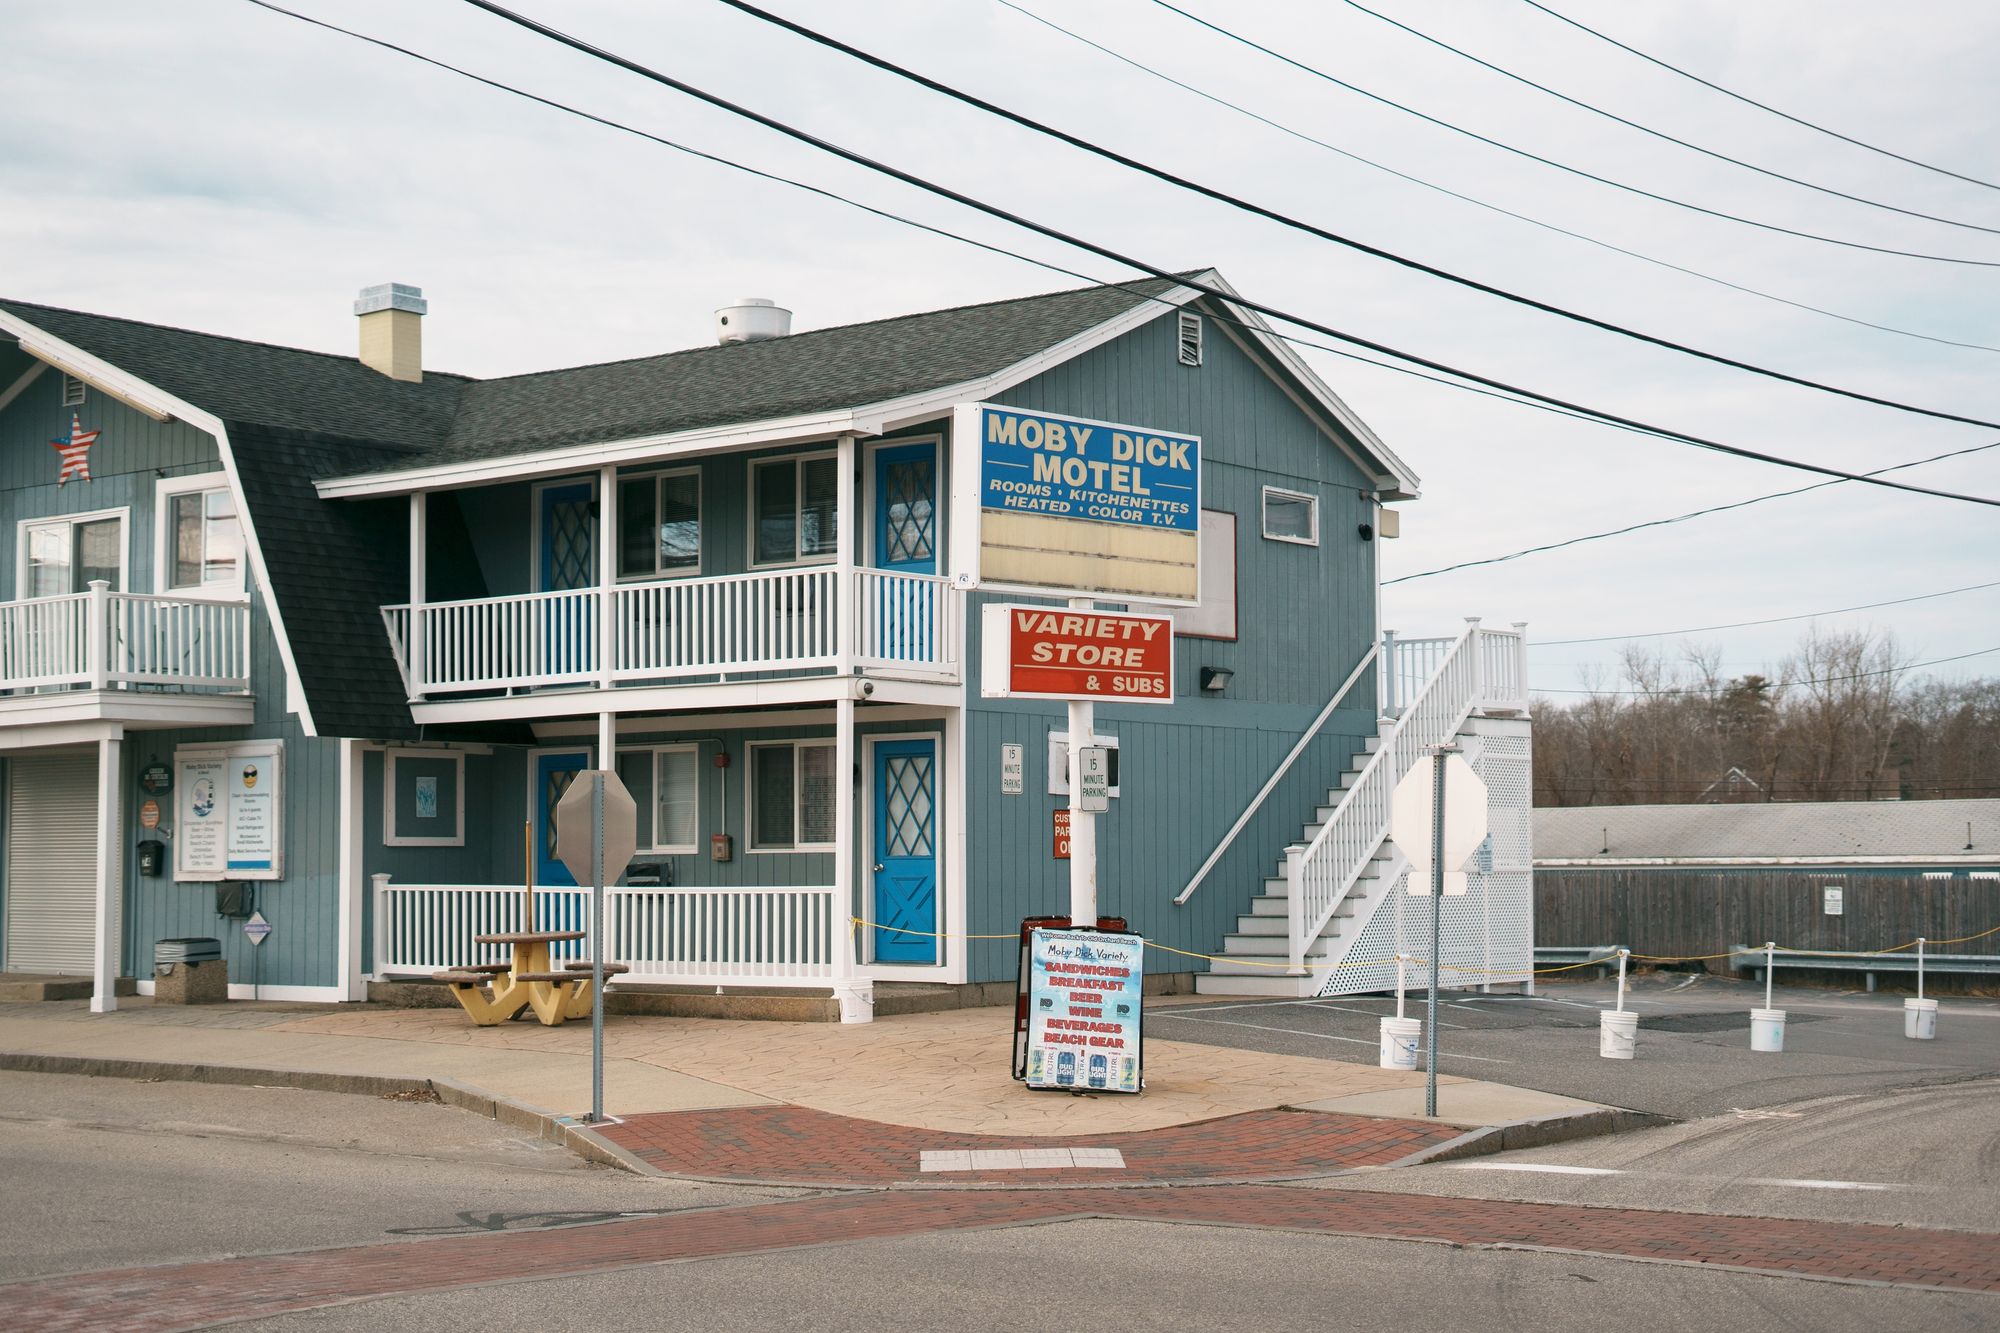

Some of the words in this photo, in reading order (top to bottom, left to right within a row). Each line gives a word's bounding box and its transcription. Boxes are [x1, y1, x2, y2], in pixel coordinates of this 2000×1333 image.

[988, 414, 1093, 455] MOBY
[1113, 433, 1192, 470] DICK
[1034, 454, 1150, 495] MOTEL
[990, 480, 1051, 497] ROOMS
[1069, 489, 1189, 514] KITCHENETTES
[1004, 495, 1070, 513] HEATED
[1088, 506, 1142, 522] COLOR
[1152, 512, 1176, 526] T.V.
[1016, 613, 1162, 641] VARIETY
[1032, 642, 1144, 667] STORE
[1087, 676, 1100, 691] &
[1113, 676, 1164, 694] SUBS
[1009, 749, 1016, 759] 15
[1004, 763, 1020, 774] MINUTE
[1090, 759, 1097, 770] 15
[1004, 779, 1020, 789] PARKING
[1084, 774, 1104, 785] MINUTE
[1083, 788, 1106, 798] PARKING
[1055, 814, 1070, 822] CUST
[1055, 826, 1070, 836] PAR
[1048, 945, 1072, 959] Moby
[1075, 946, 1093, 958] Dick
[1097, 948, 1128, 963] Variety
[1045, 962, 1130, 977] SANDWICHES
[1049, 976, 1125, 991] BREAKFAST
[1070, 992, 1102, 1004] BEER
[1069, 1006, 1102, 1018] WINE
[1047, 1018, 1123, 1034] BEVERAGES
[1044, 1032, 1086, 1045] BEACH
[1089, 1036, 1124, 1048] GEAR
